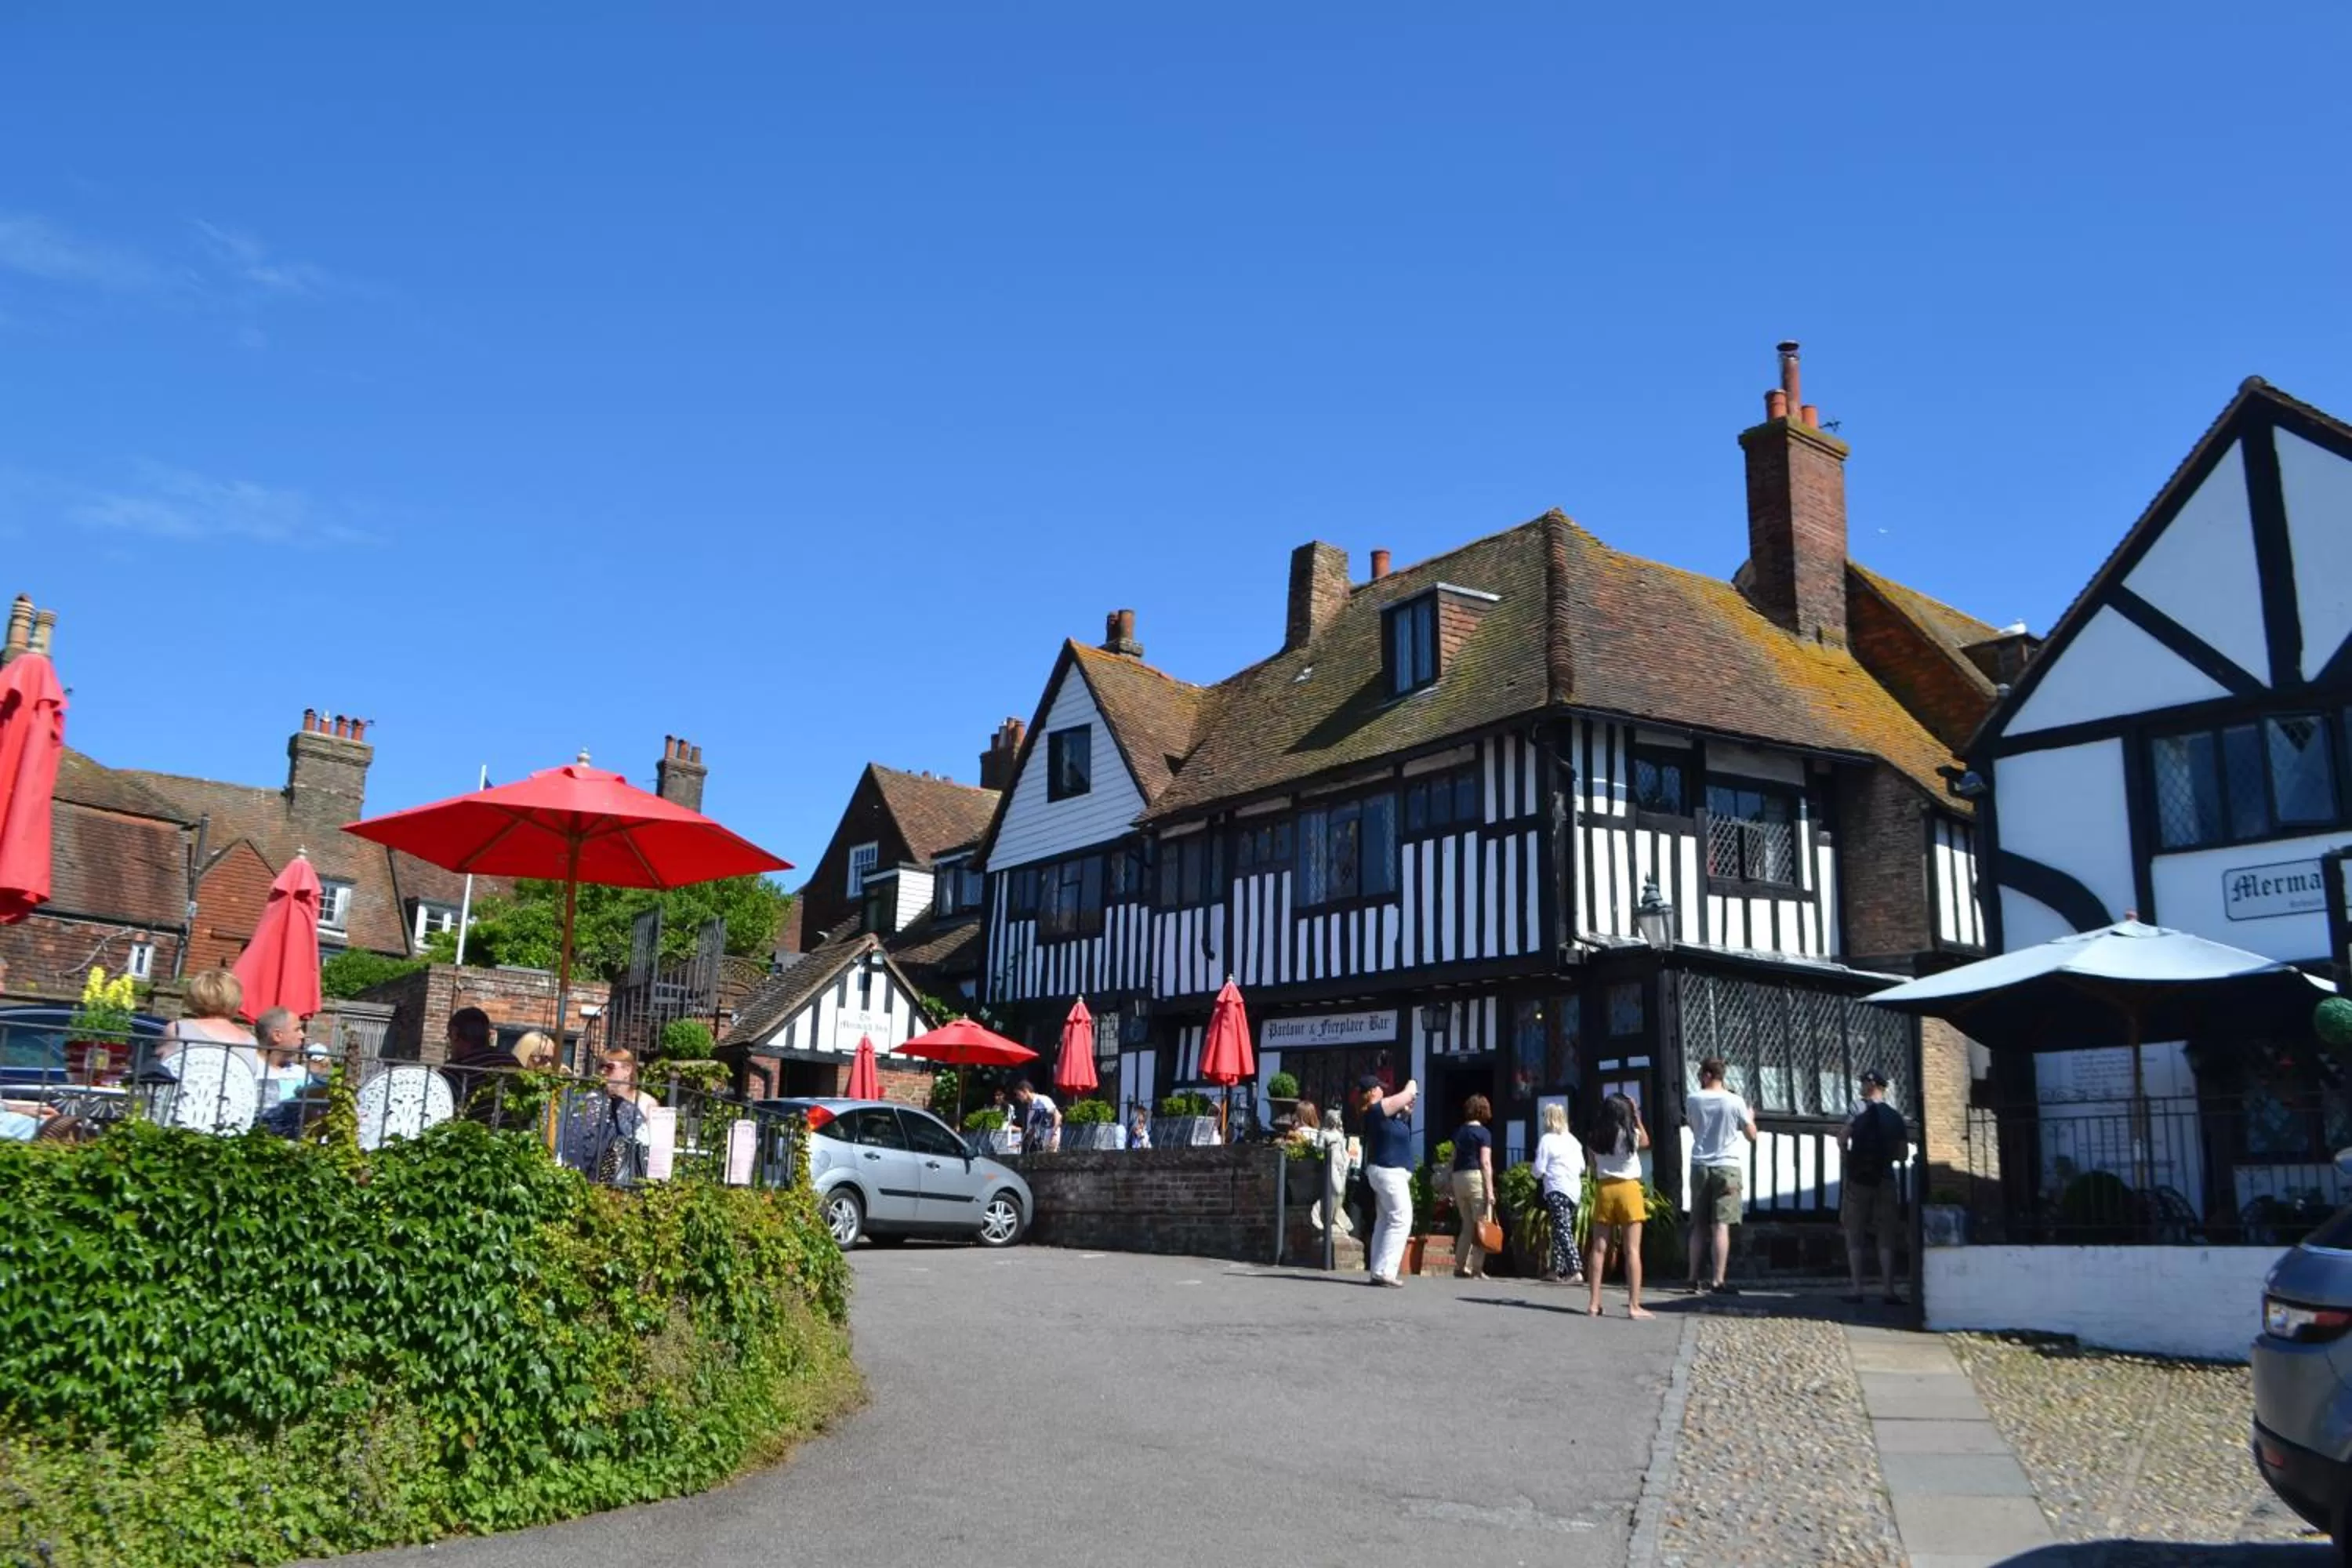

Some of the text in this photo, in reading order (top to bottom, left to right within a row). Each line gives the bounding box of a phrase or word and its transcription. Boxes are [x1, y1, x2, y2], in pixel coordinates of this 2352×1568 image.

[2232, 873, 2321, 902] Merma
[1318, 1018, 1364, 1036] Fireplace
[1369, 1014, 1389, 1031] Bar
